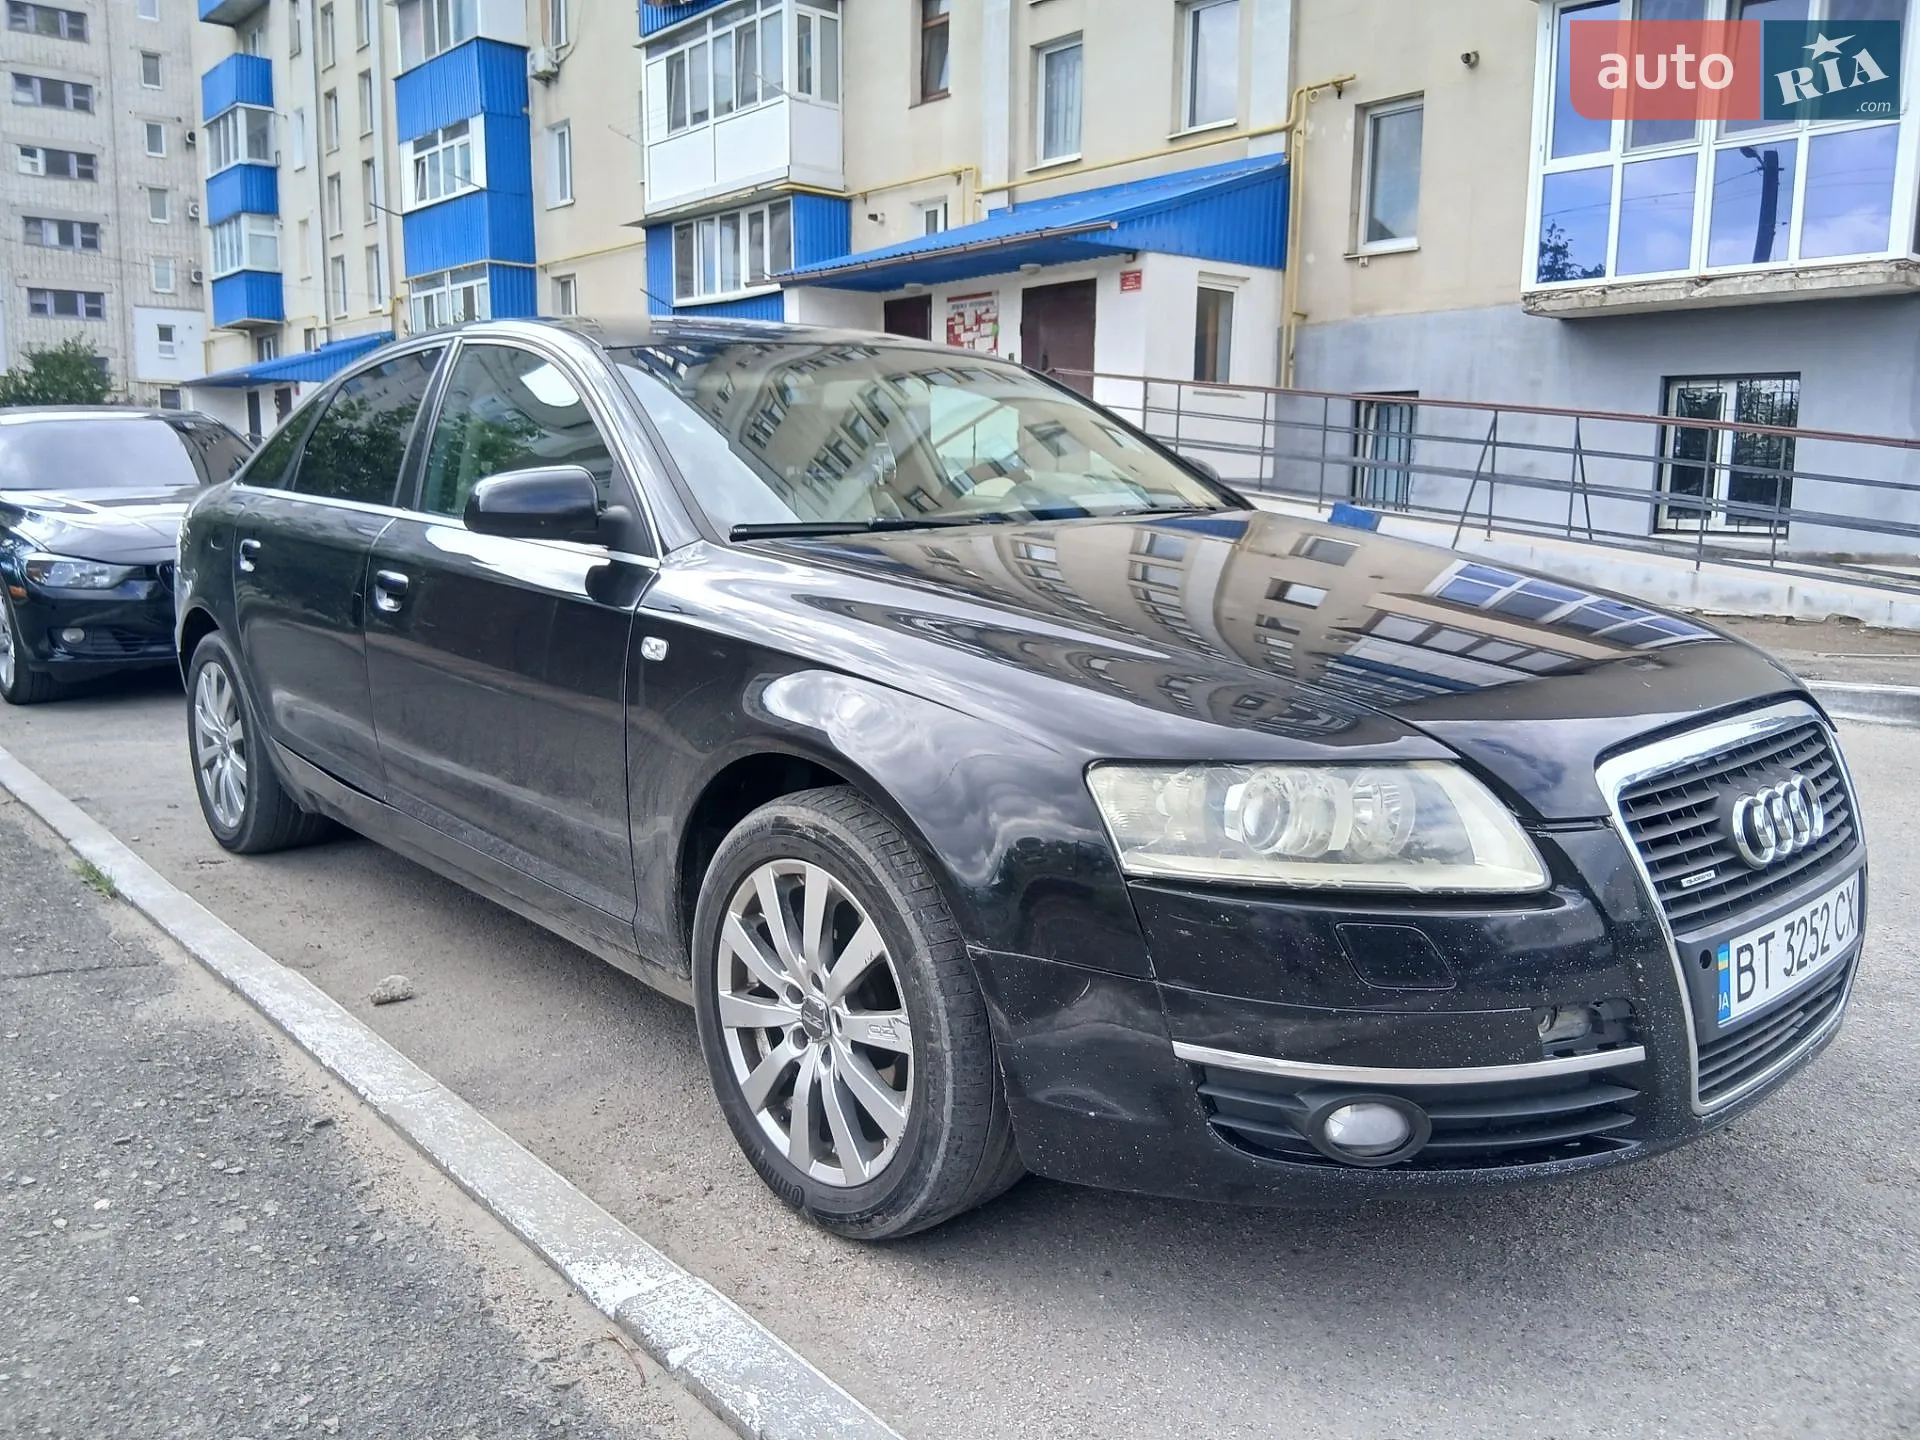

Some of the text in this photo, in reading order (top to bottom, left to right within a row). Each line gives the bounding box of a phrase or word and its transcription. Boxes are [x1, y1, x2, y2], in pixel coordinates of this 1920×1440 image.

[1736, 879, 1856, 1004] BT 3252 CX
